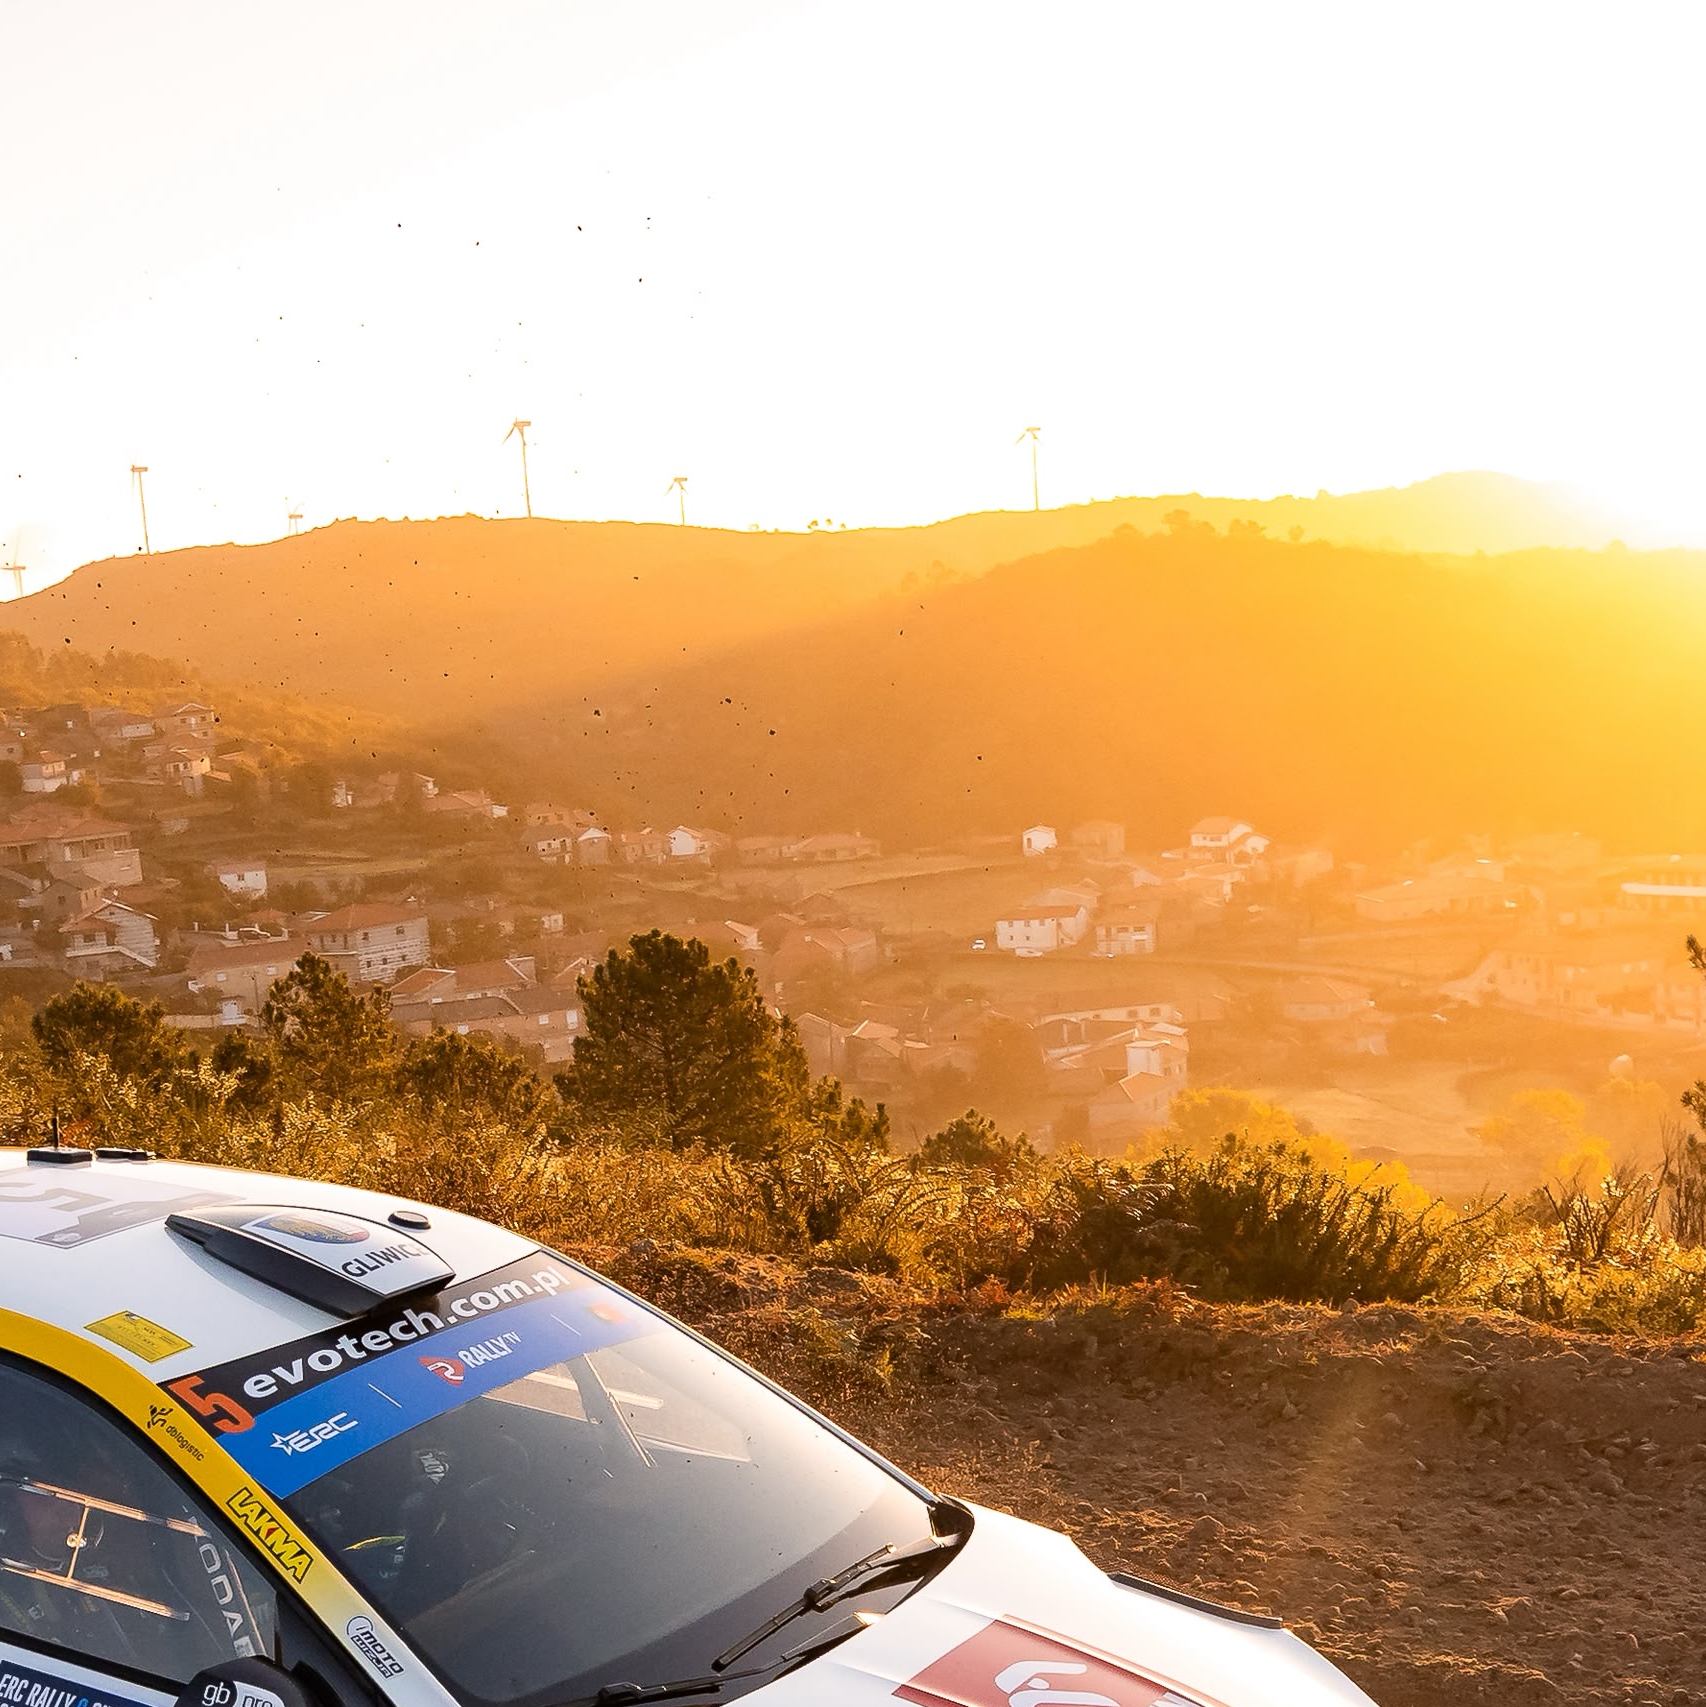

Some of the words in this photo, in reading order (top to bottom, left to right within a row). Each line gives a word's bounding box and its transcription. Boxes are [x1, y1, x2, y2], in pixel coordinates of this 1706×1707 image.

[168, 1376, 255, 1434] 5
[243, 1266, 571, 1399] evotech.com.pl
[226, 1487, 314, 1584] LAKMA
[202, 1682, 230, 1706] gb
